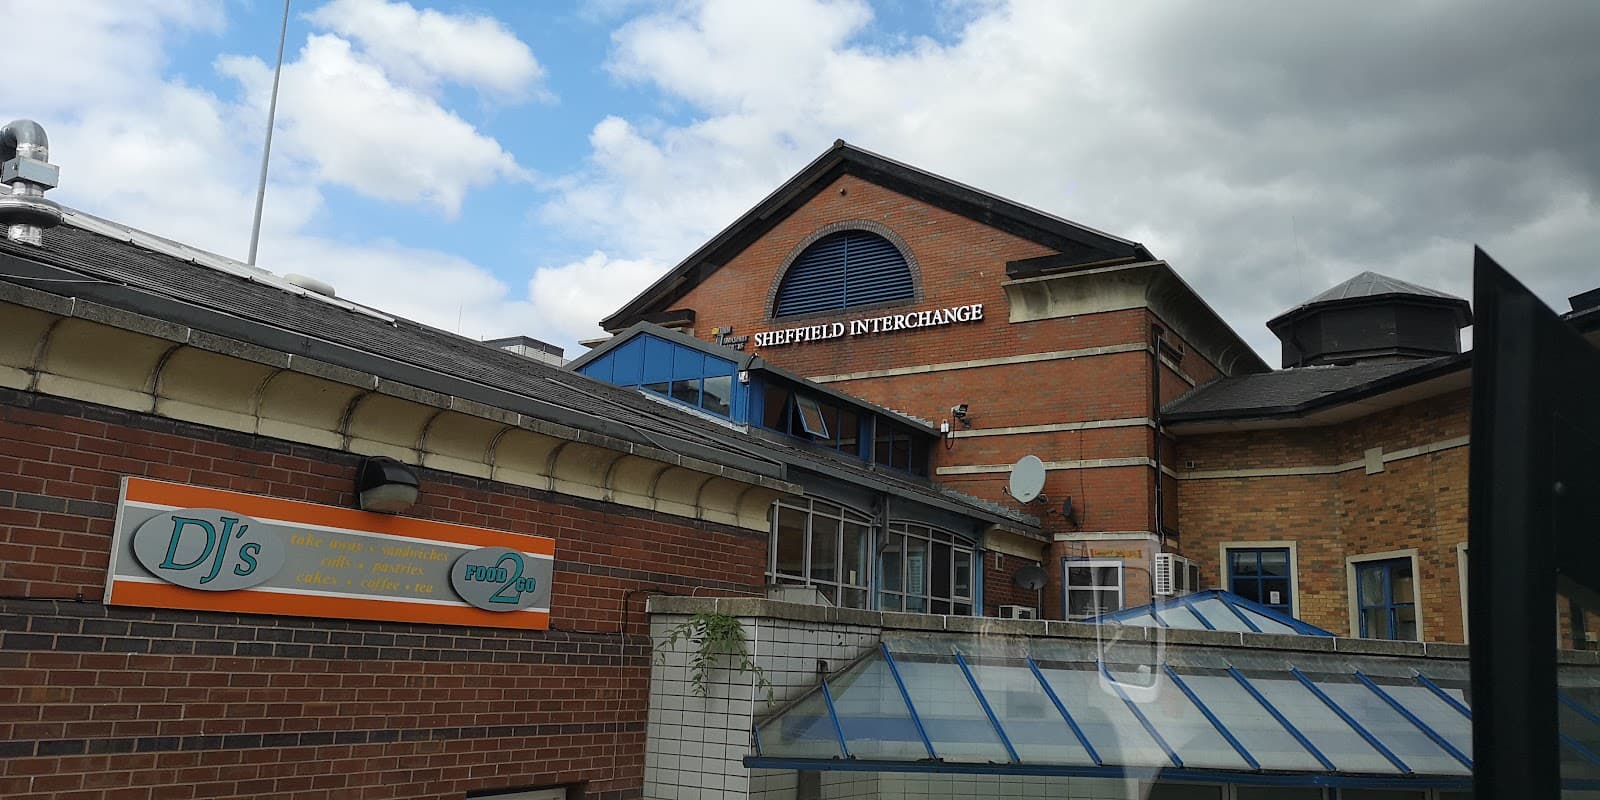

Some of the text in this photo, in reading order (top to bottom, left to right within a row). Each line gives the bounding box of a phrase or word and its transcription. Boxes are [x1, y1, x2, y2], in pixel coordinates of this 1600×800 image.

[754, 322, 845, 347] SHEFFIELD
[850, 303, 983, 336] INTERCHANGE
[159, 515, 261, 584] DJ's
[290, 532, 448, 561] take away sandwiches
[296, 571, 433, 593] cakes coffee tea
[372, 562, 424, 577] pastries
[465, 552, 536, 604] FOOD 2 GO
